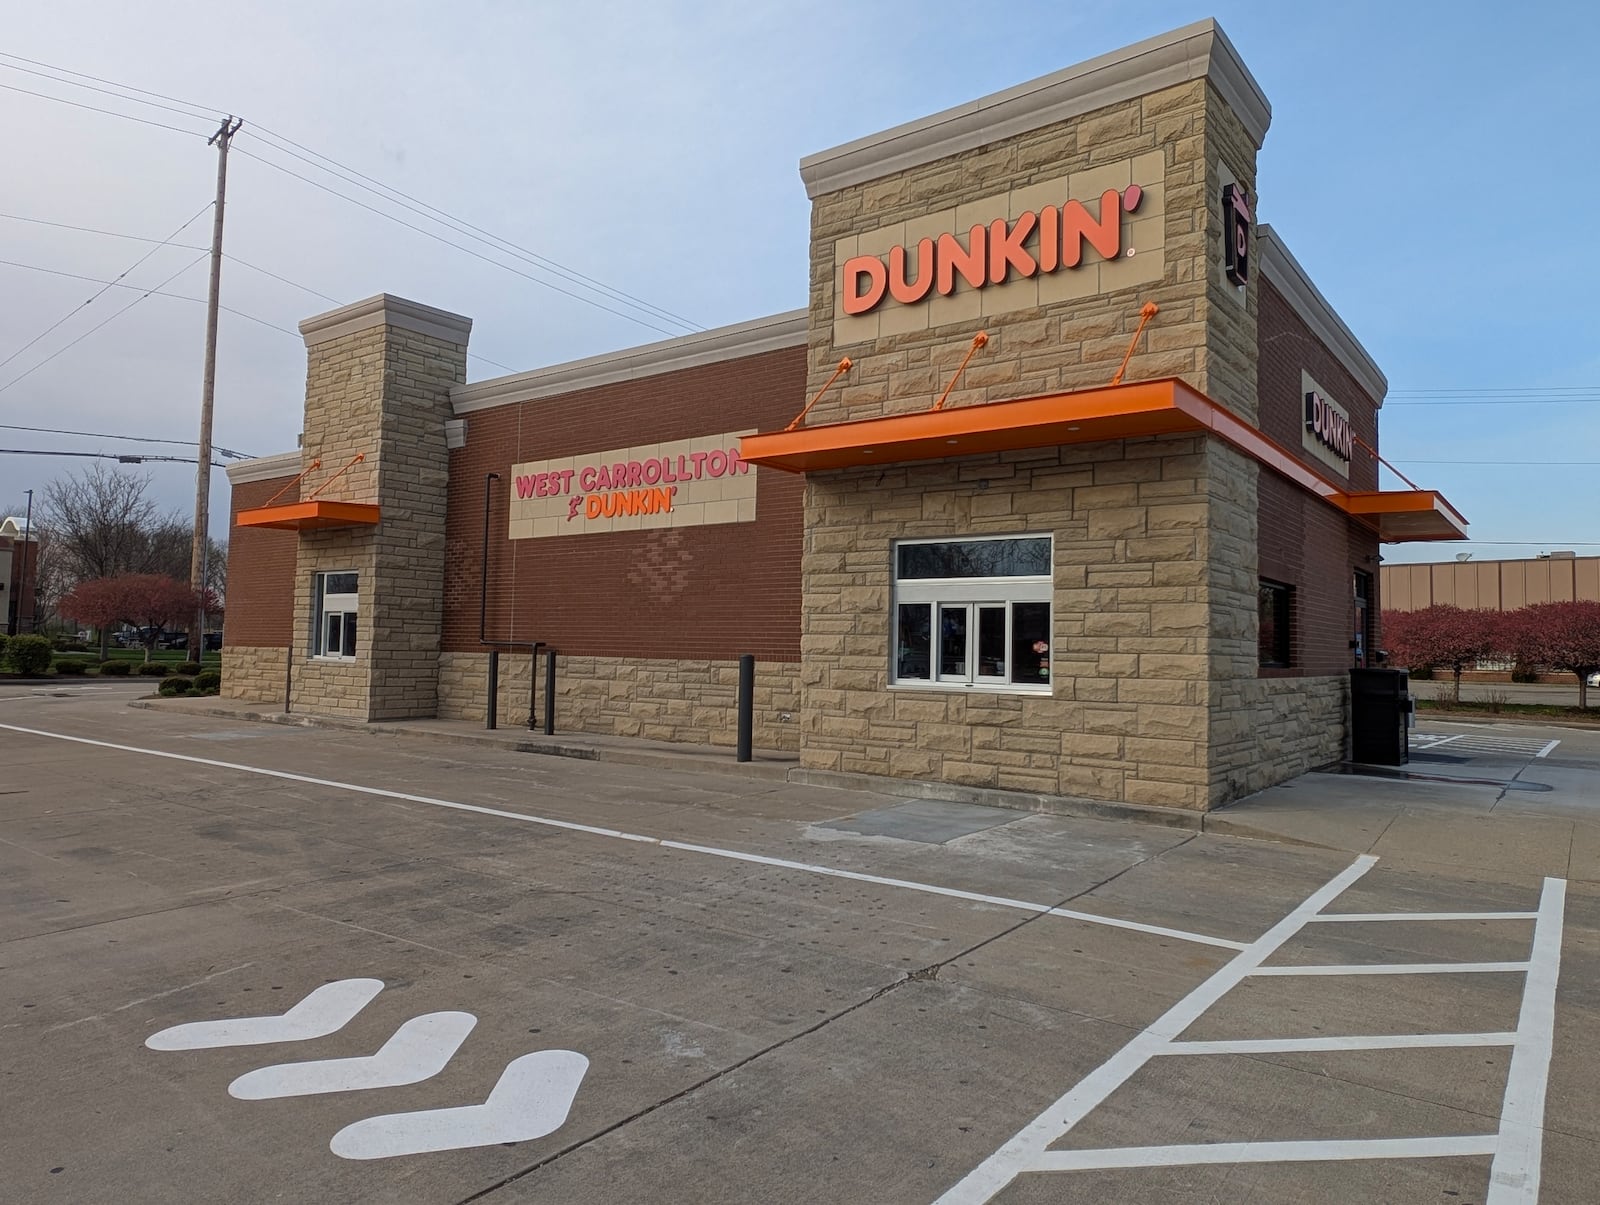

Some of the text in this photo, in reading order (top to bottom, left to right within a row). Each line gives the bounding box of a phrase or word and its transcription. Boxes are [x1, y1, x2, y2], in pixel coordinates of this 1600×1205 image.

[843, 184, 1143, 315] DUNKIN'
[516, 469, 574, 499] WEST
[585, 486, 677, 519] DUNKIN'
